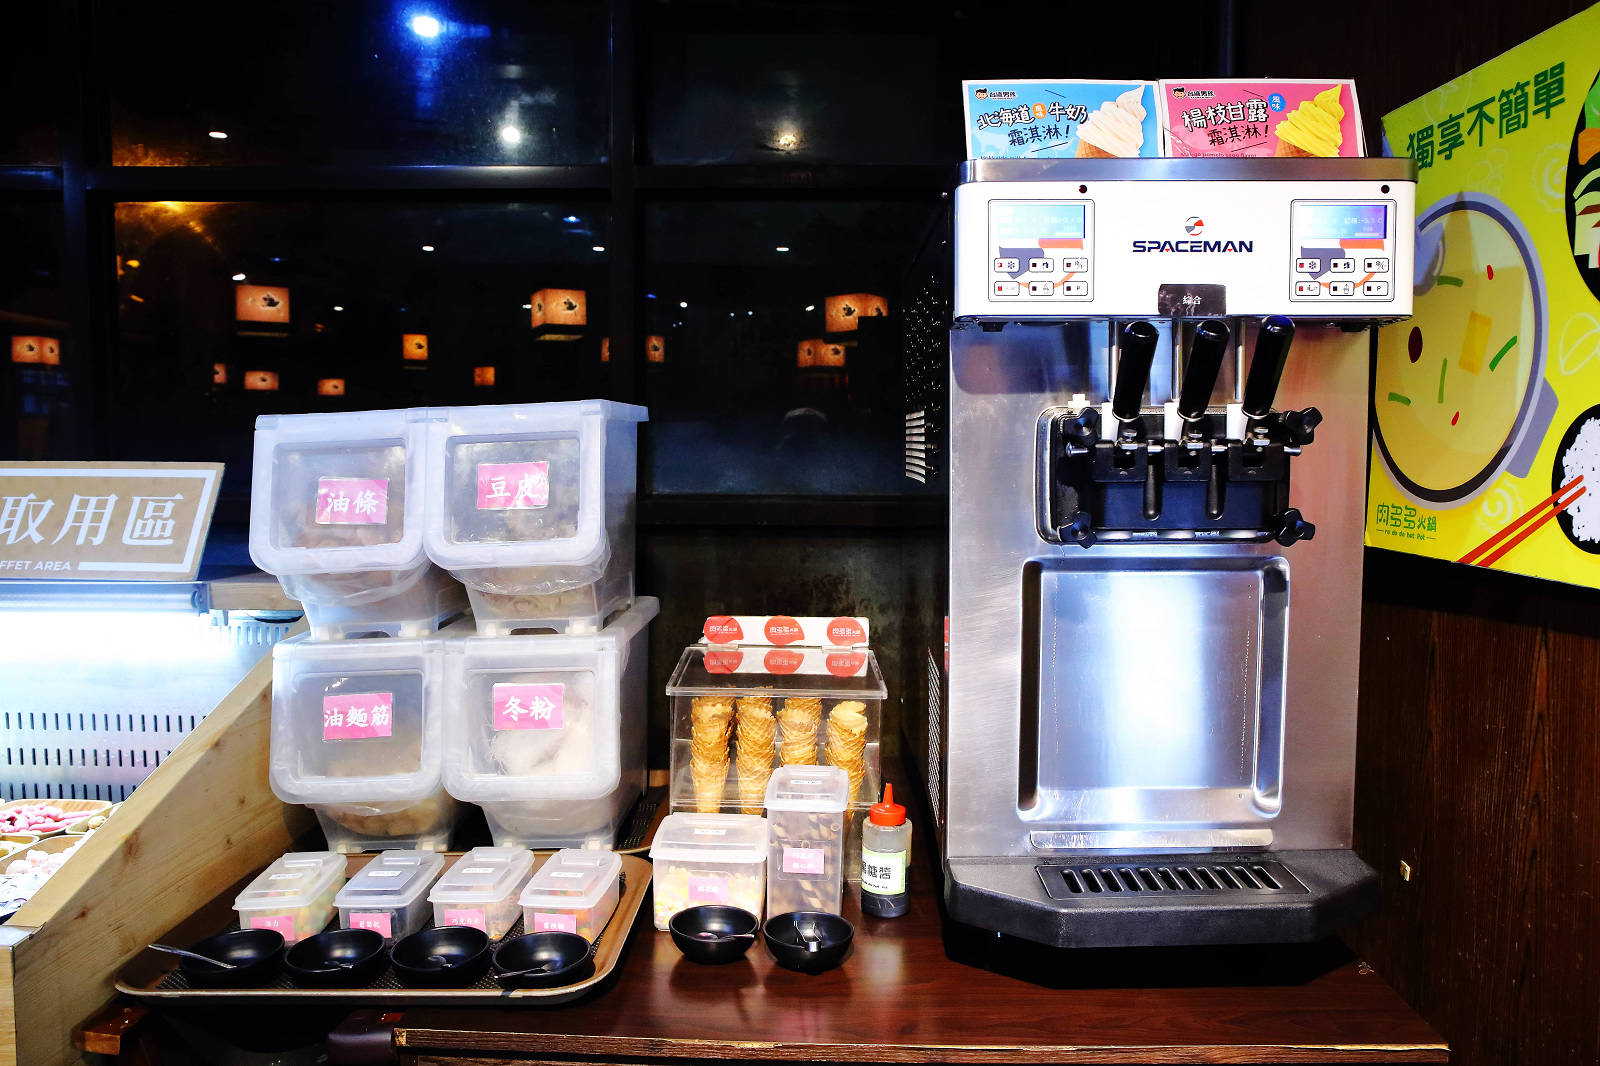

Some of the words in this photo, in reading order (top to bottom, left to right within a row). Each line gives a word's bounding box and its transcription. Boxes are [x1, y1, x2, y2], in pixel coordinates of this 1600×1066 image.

[1181, 98, 1269, 132] 楊枝甘露
[1271, 96, 1282, 111] 風味
[1406, 61, 1566, 170] 獨享不簡單
[976, 105, 1035, 131] 北海道
[1048, 102, 1088, 124] 牛奶
[1007, 124, 1070, 147] 霜淇淋!
[1207, 124, 1269, 147] 霜淇淋!
[1132, 240, 1254, 253] SPACEMAN
[485, 473, 542, 503] 豆皮
[326, 492, 379, 514] 油條
[0, 492, 185, 546] 取用區
[1376, 502, 1437, 532] 肉多多火鍋
[33, 560, 72, 571] AREA
[323, 705, 389, 728] 油麵筋
[502, 695, 557, 721] 冬粉
